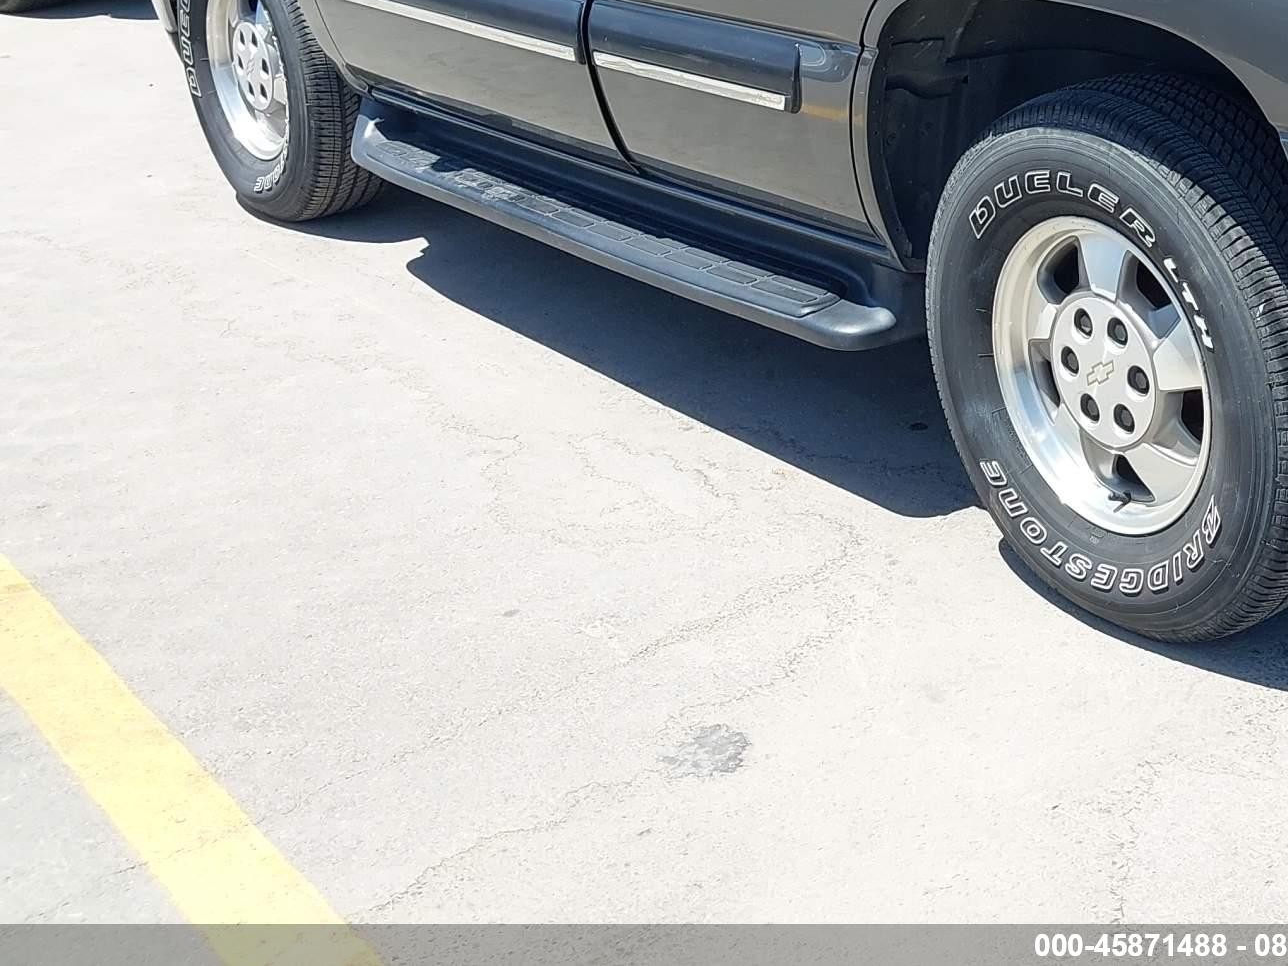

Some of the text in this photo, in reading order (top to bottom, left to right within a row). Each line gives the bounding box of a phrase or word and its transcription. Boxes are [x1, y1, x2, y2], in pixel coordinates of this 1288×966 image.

[969, 169, 1215, 350] DUELER LTH
[979, 459, 1222, 595] BRIDGESTONE
